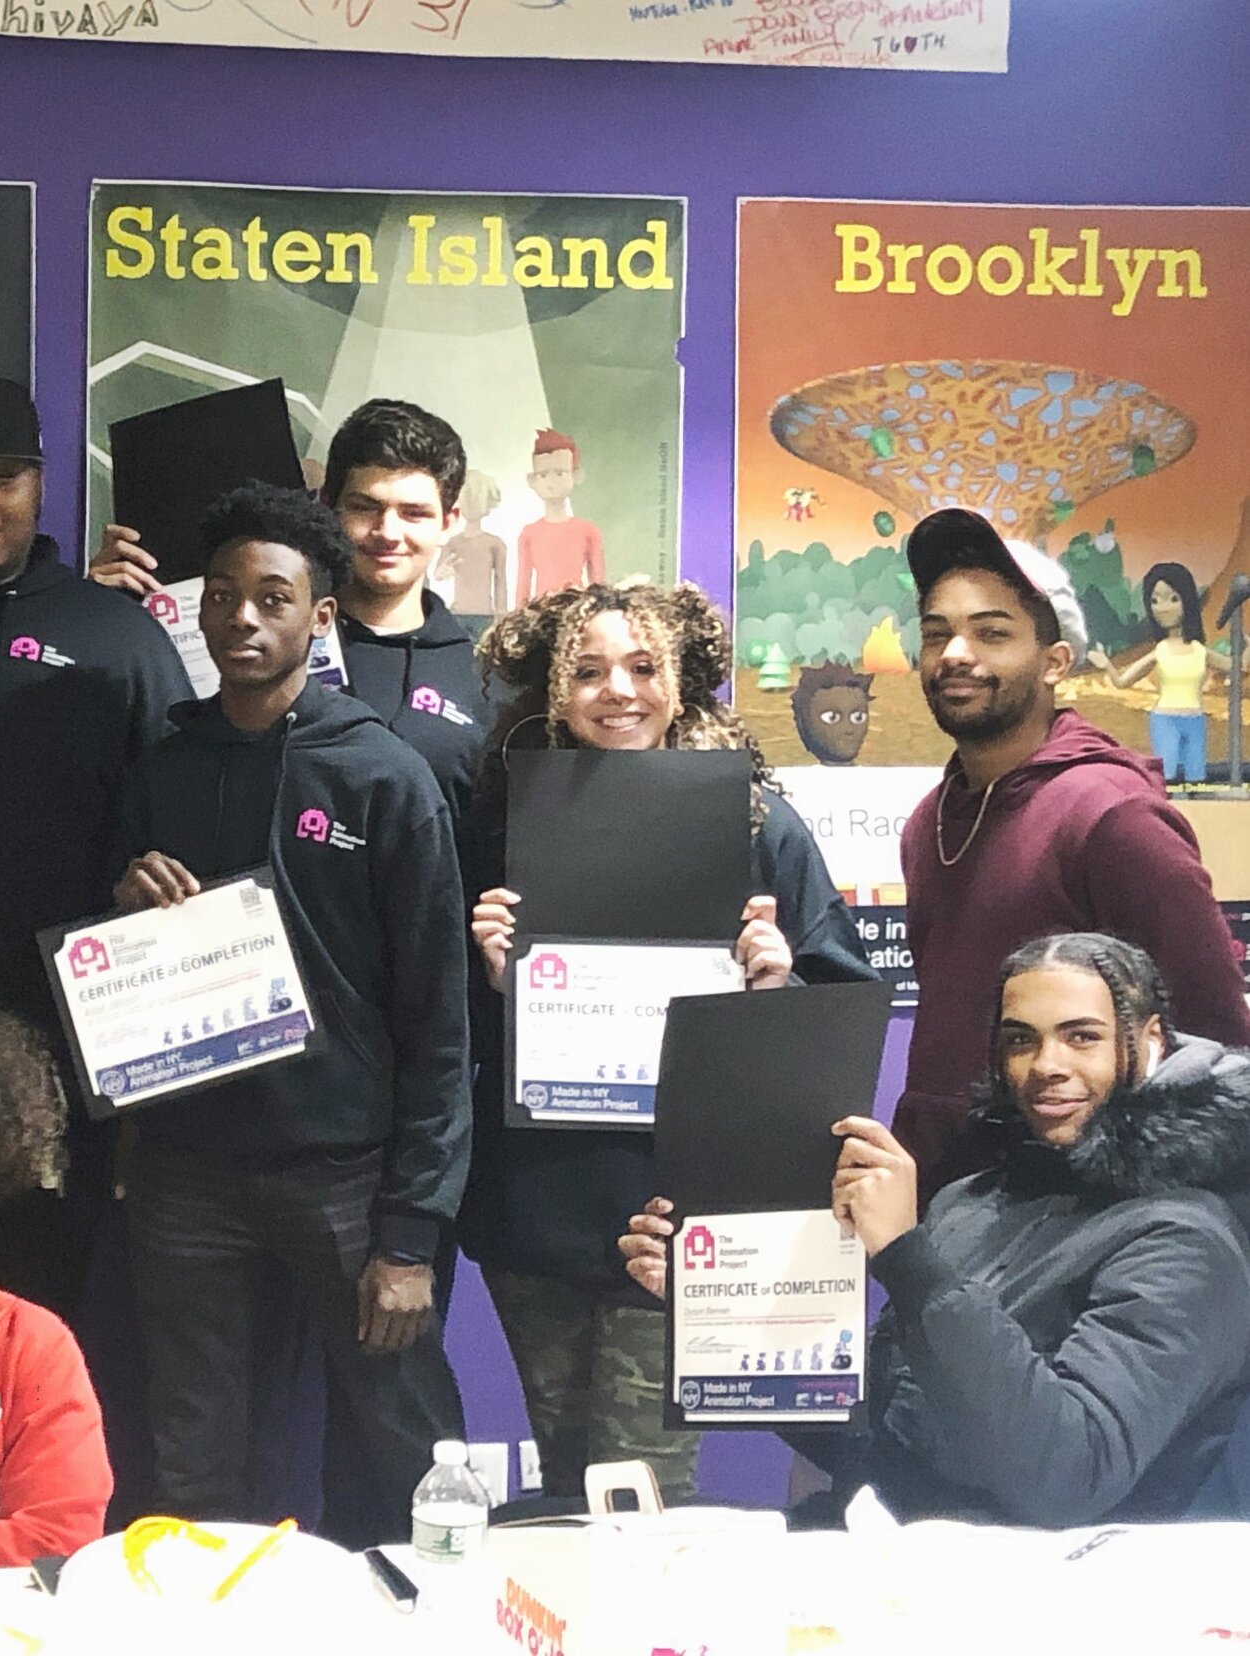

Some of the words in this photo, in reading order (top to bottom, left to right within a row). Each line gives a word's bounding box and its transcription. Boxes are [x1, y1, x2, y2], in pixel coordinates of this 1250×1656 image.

[104, 206, 378, 285] Staten
[405, 214, 674, 290] Island
[834, 223, 1208, 317] Brooklyn
[886, 916, 906, 940] in
[867, 944, 915, 968] atio
[79, 968, 164, 1002] CERTIFICATE
[181, 934, 276, 972] COMPLETION
[528, 1002, 615, 1016] CERTIFICATE
[635, 1005, 668, 1017] COM
[552, 1087, 580, 1097] Made
[552, 1098, 601, 1109] Animation
[604, 1099, 638, 1111] Project
[719, 1235, 733, 1243] The
[719, 1260, 747, 1269] Project
[684, 1283, 757, 1298] CERTIFICATE
[774, 1279, 855, 1296] COMPLETION
[703, 1382, 727, 1393] Made
[497, 1598, 524, 1645] BOX
